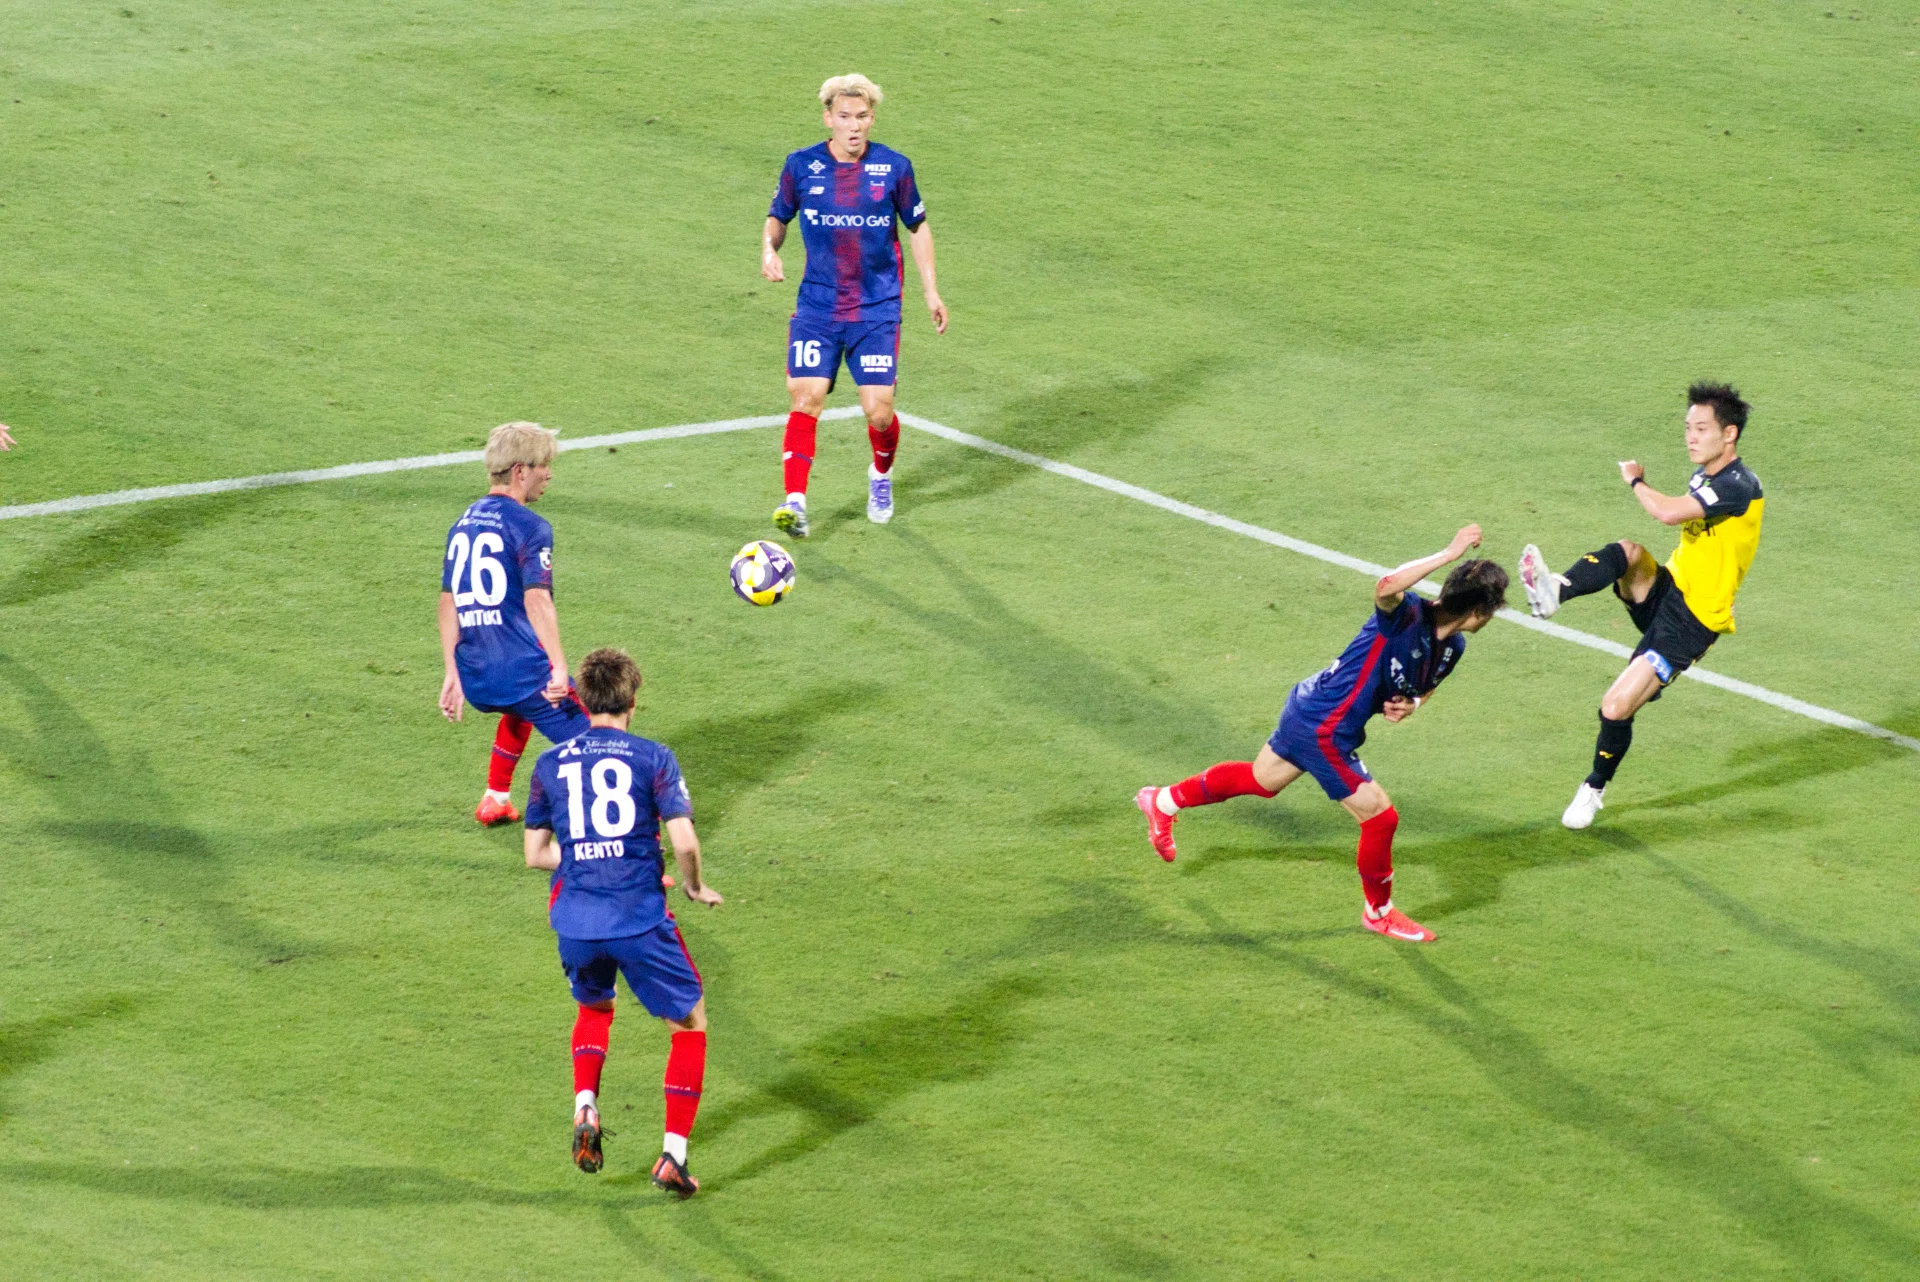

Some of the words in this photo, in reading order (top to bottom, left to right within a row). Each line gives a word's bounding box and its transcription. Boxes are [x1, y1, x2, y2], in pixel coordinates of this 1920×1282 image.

[865, 164, 892, 172] MIXI
[819, 214, 864, 226] TOKYO
[866, 215, 891, 227] GAS
[792, 340, 822, 368] 16
[860, 355, 893, 367] MIXI
[447, 532, 508, 608] 26
[557, 758, 636, 840] 18
[574, 840, 625, 861] KENTO
